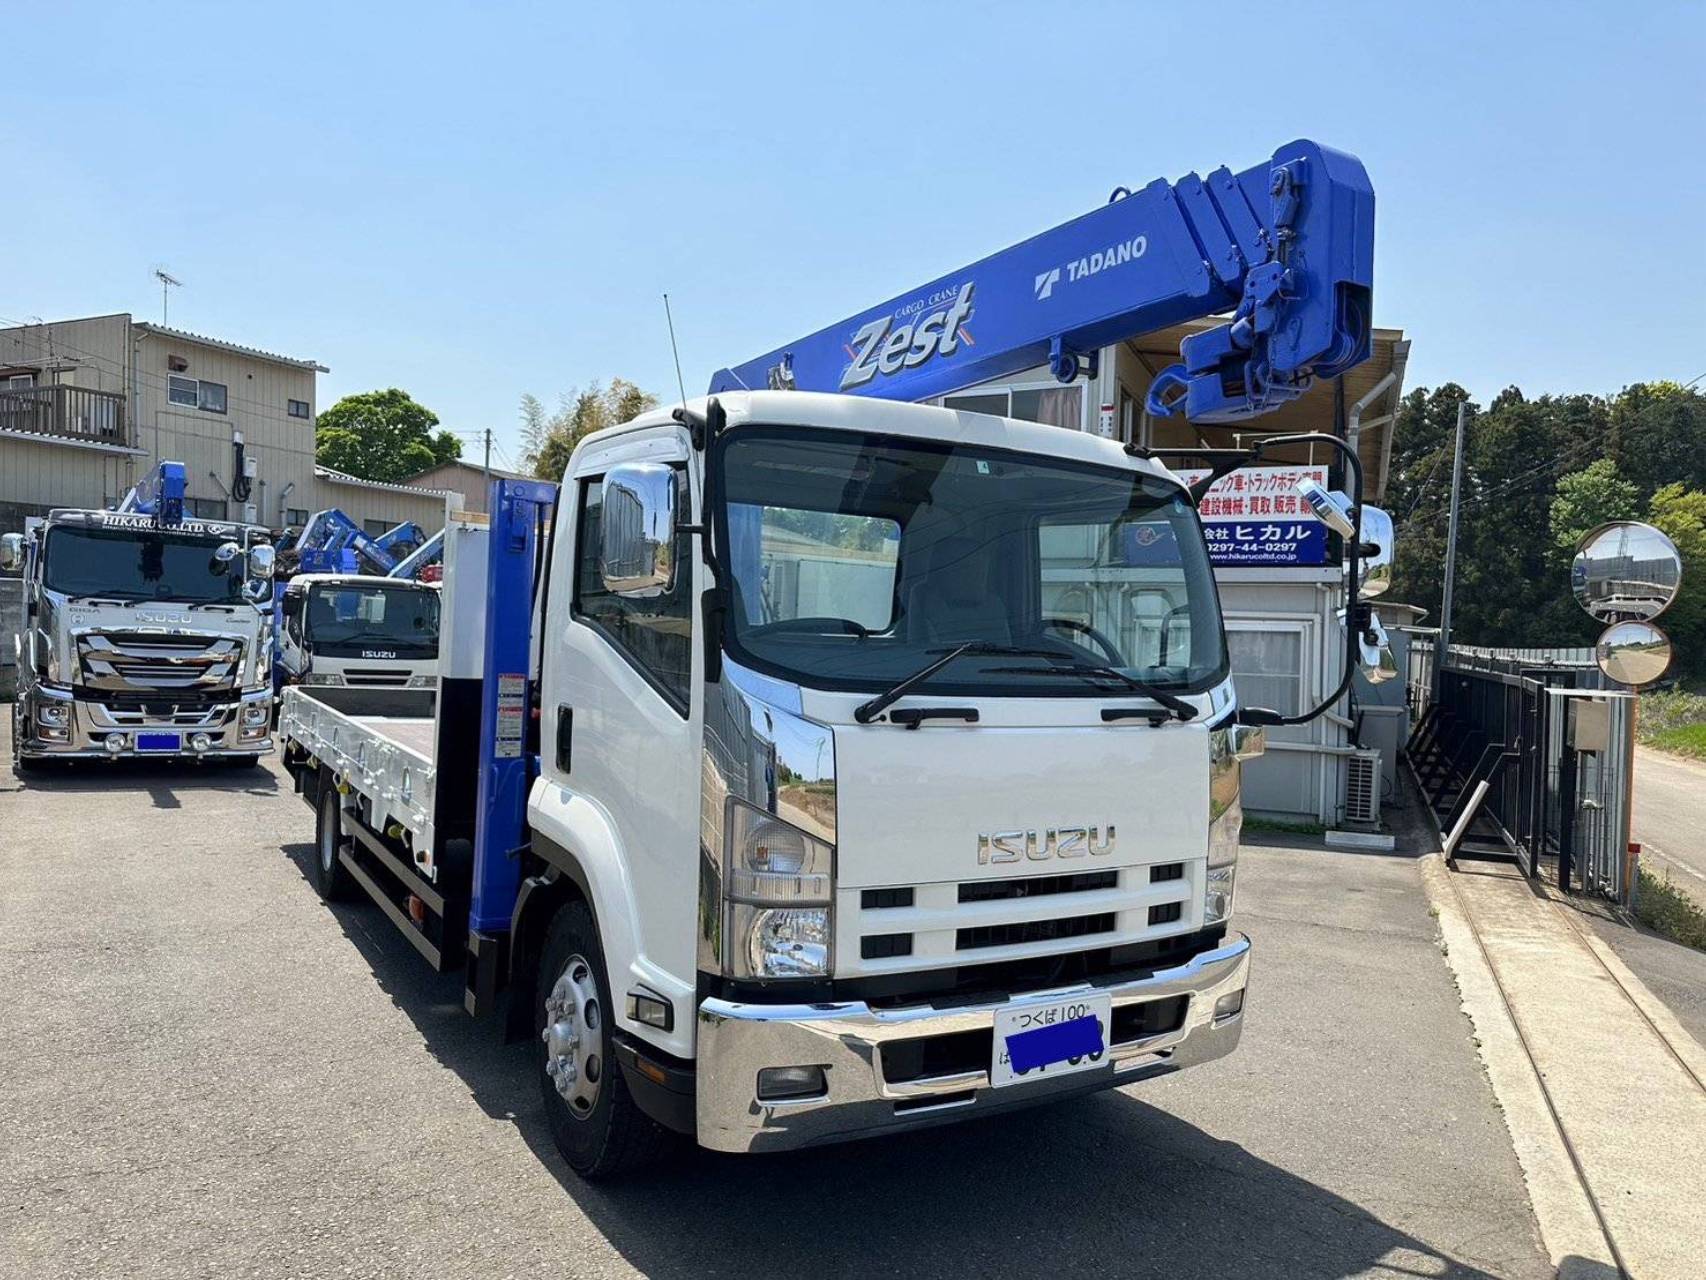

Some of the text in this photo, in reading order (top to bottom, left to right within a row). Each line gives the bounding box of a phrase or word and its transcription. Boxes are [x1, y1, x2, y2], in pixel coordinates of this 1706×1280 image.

[1066, 235, 1148, 282] TADANO
[894, 284, 959, 321] CARGO CRANE
[839, 280, 975, 392] Zest
[102, 514, 157, 530] HIKARU
[135, 608, 194, 624] ISUZU
[361, 650, 397, 659] ISUZU
[977, 825, 1116, 865] ISUZU
